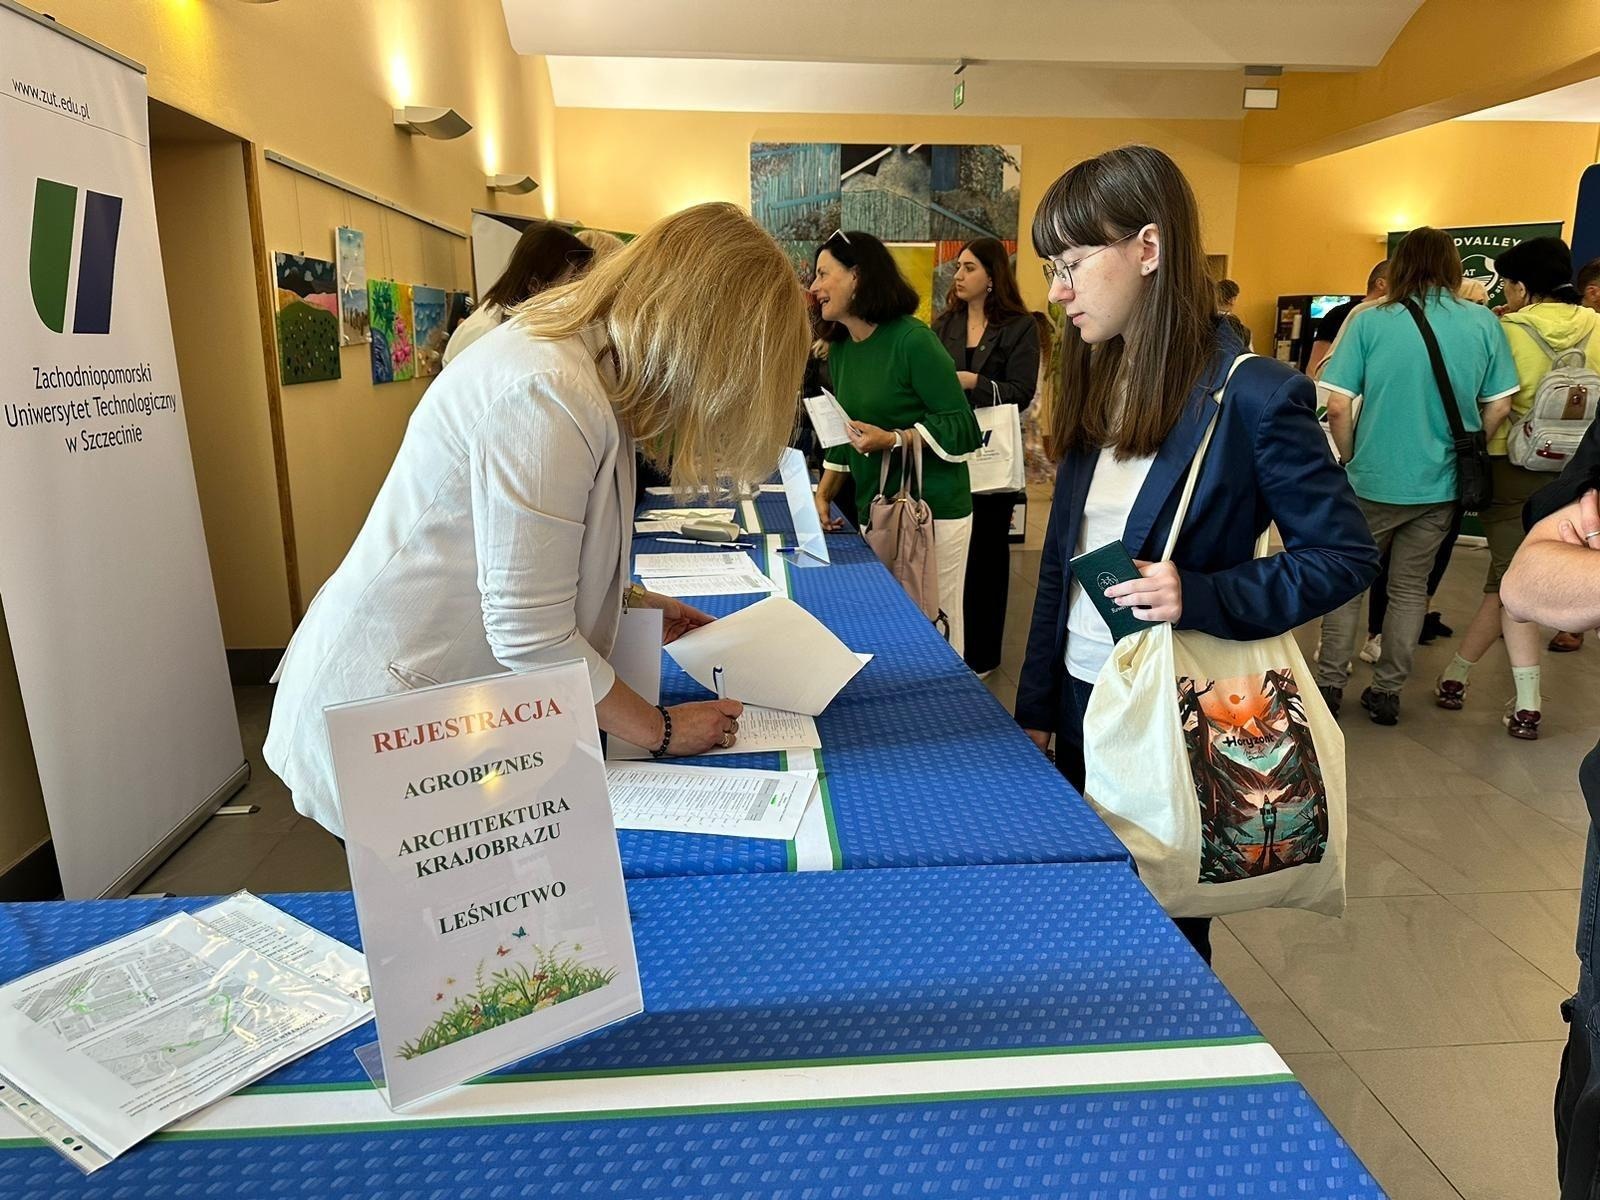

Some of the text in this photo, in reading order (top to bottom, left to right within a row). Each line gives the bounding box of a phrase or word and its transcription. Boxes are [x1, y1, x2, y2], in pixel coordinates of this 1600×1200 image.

[12, 79, 91, 119] www.zut.edu.pl
[1454, 237, 1521, 247] DVALLEY
[33, 363, 152, 391] Zachodniopomorski
[5, 392, 177, 428] Uniwersytet Technologiczny
[65, 424, 142, 454] w Szczecinie
[372, 698, 562, 753] REJESTRACJA
[405, 752, 544, 799] AGROBIZNES
[398, 798, 570, 857] ARCHITEKTURA
[415, 822, 561, 878] KRAJOBRAZU
[439, 881, 566, 934] LEŚNICTWO
